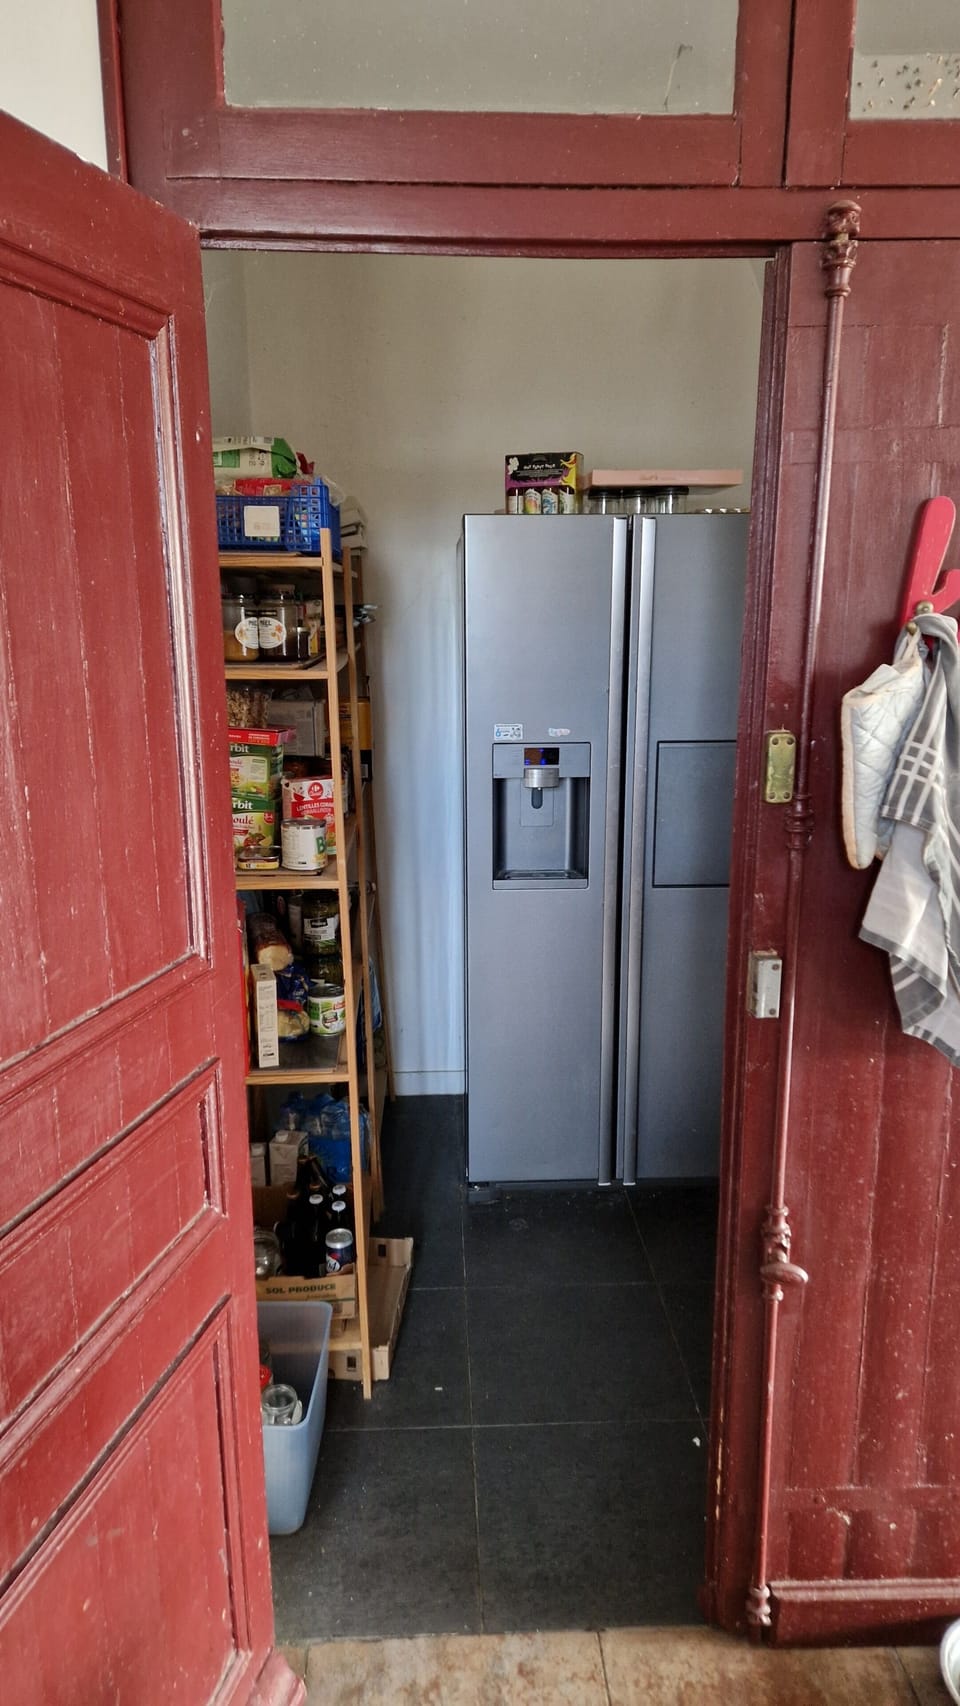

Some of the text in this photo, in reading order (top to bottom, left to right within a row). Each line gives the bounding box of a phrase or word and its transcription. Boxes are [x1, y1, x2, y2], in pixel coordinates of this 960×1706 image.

[230, 744, 249, 753] rbit
[232, 800, 253, 810] rbit
[233, 815, 255, 825] oulé
[288, 1284, 336, 1293] PRODUCE
